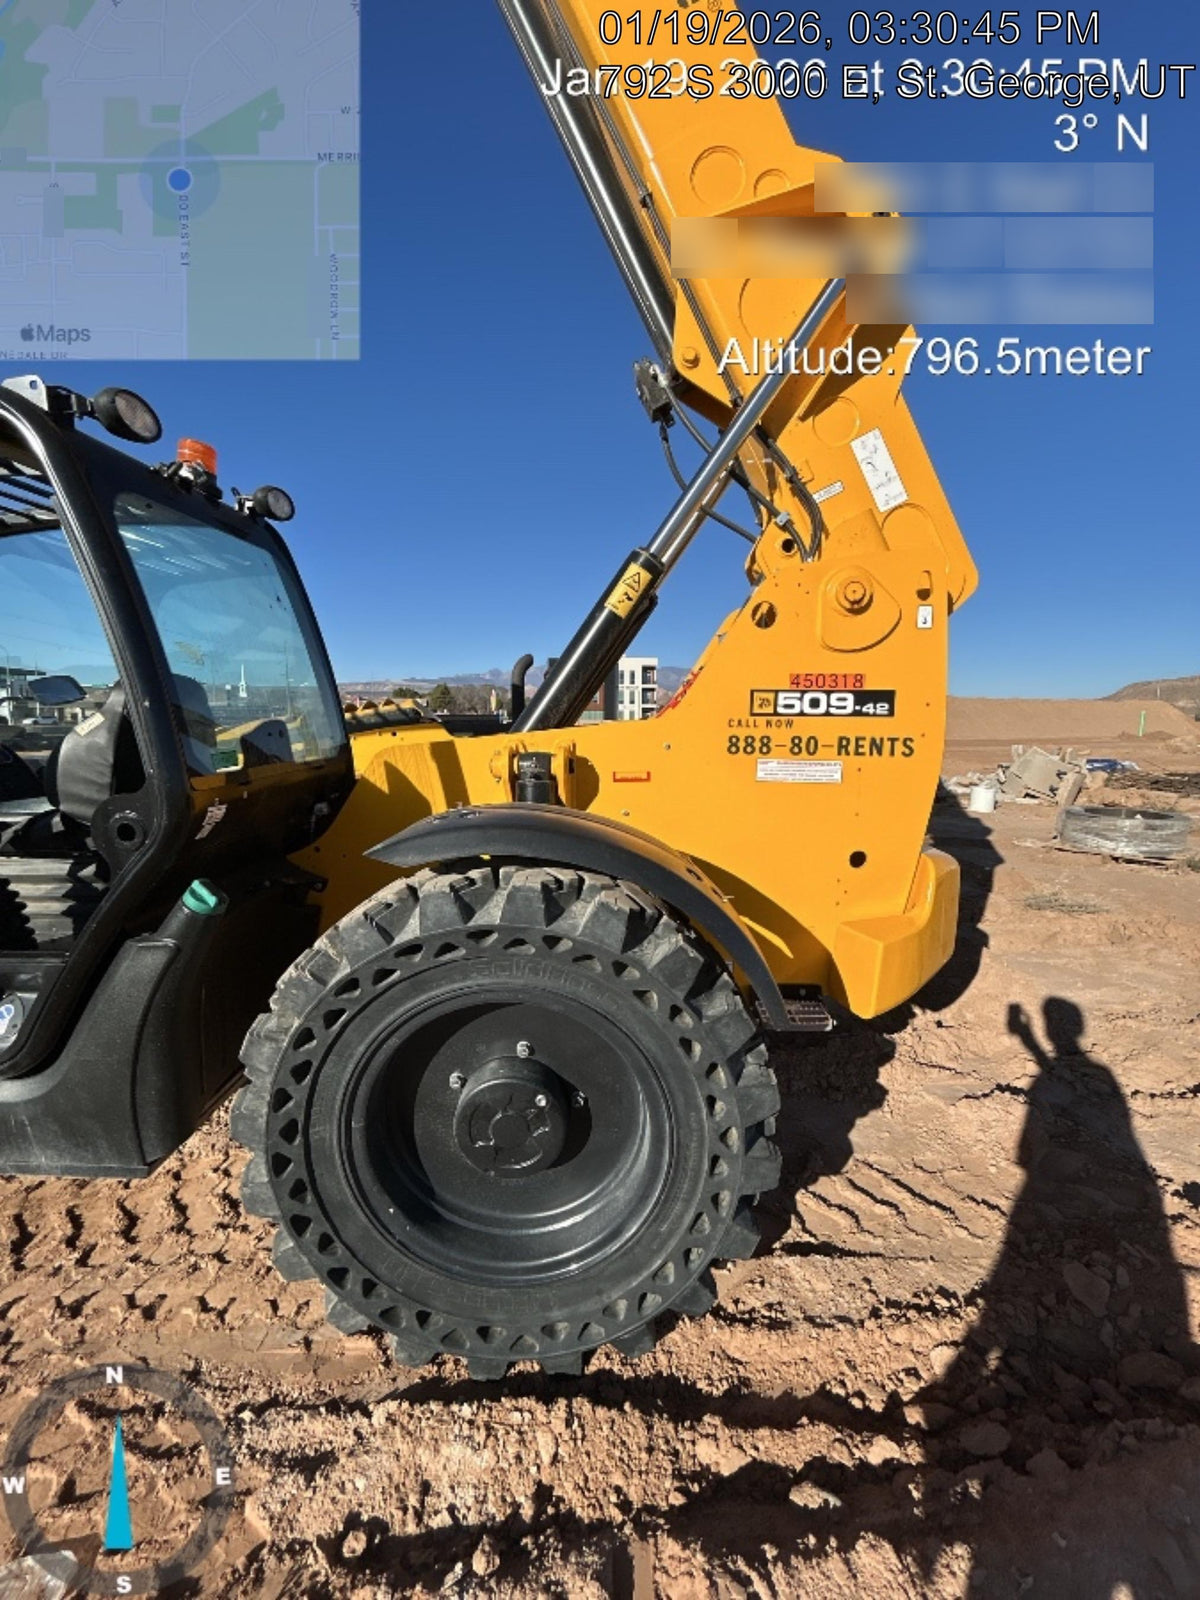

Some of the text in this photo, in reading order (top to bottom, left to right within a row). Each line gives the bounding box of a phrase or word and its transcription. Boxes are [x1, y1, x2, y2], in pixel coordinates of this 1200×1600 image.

[790, 673, 865, 689] 450318
[727, 718, 795, 730] CALL NOW
[727, 734, 915, 758] 888-80-RENTS
